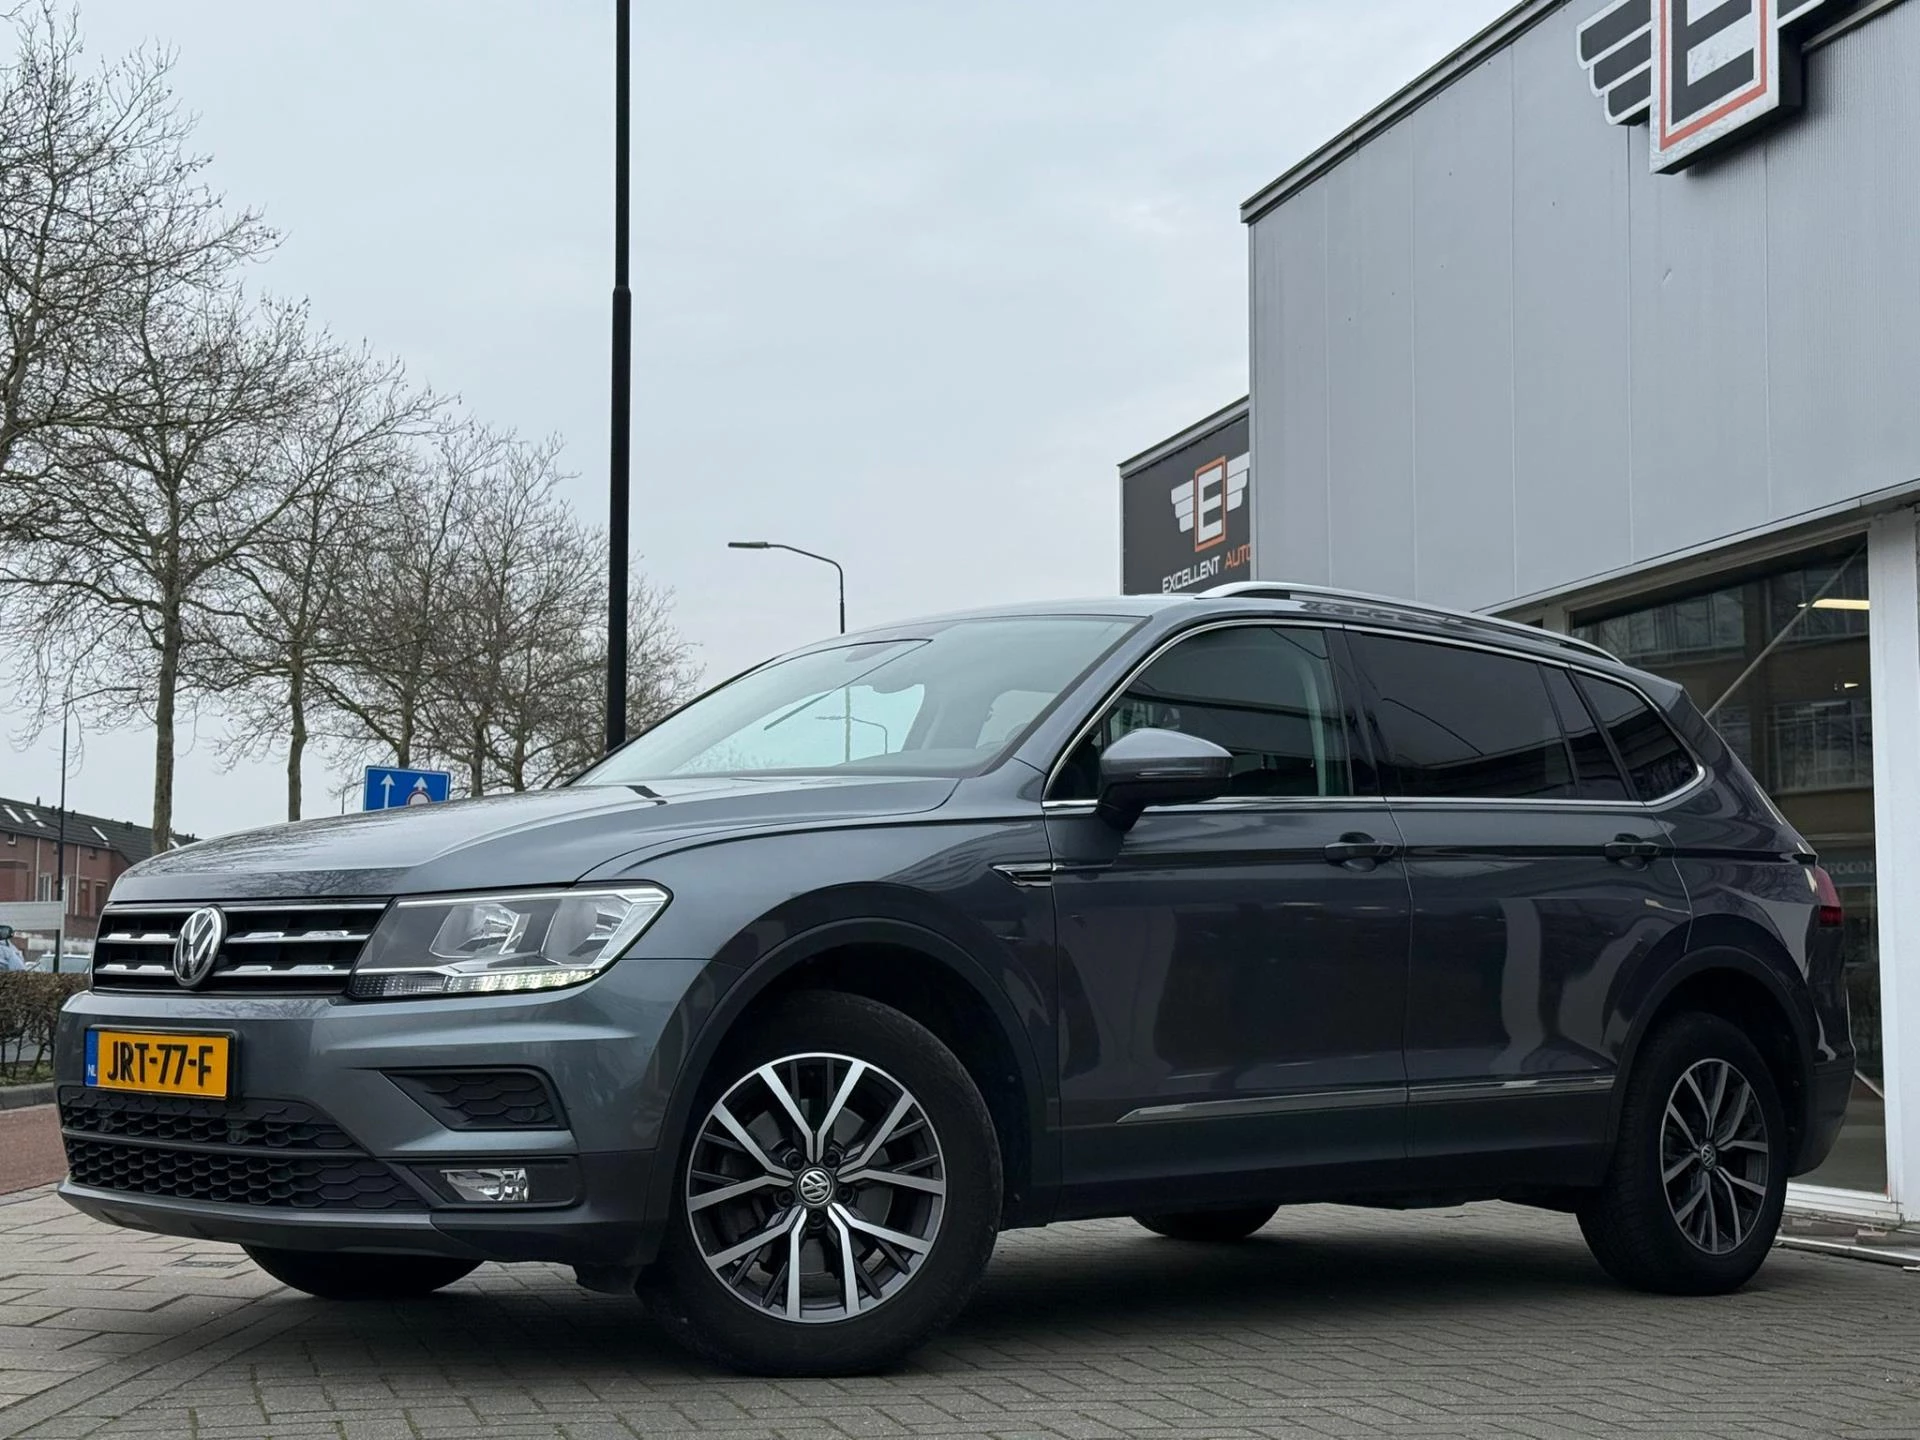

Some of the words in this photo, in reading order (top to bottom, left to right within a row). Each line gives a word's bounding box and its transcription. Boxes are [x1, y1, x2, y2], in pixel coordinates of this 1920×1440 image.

[1198, 465, 1223, 544] E
[1162, 555, 1220, 593] EXCELLENT
[87, 1063, 97, 1077] NL
[107, 1041, 213, 1087] JRT-77-F
